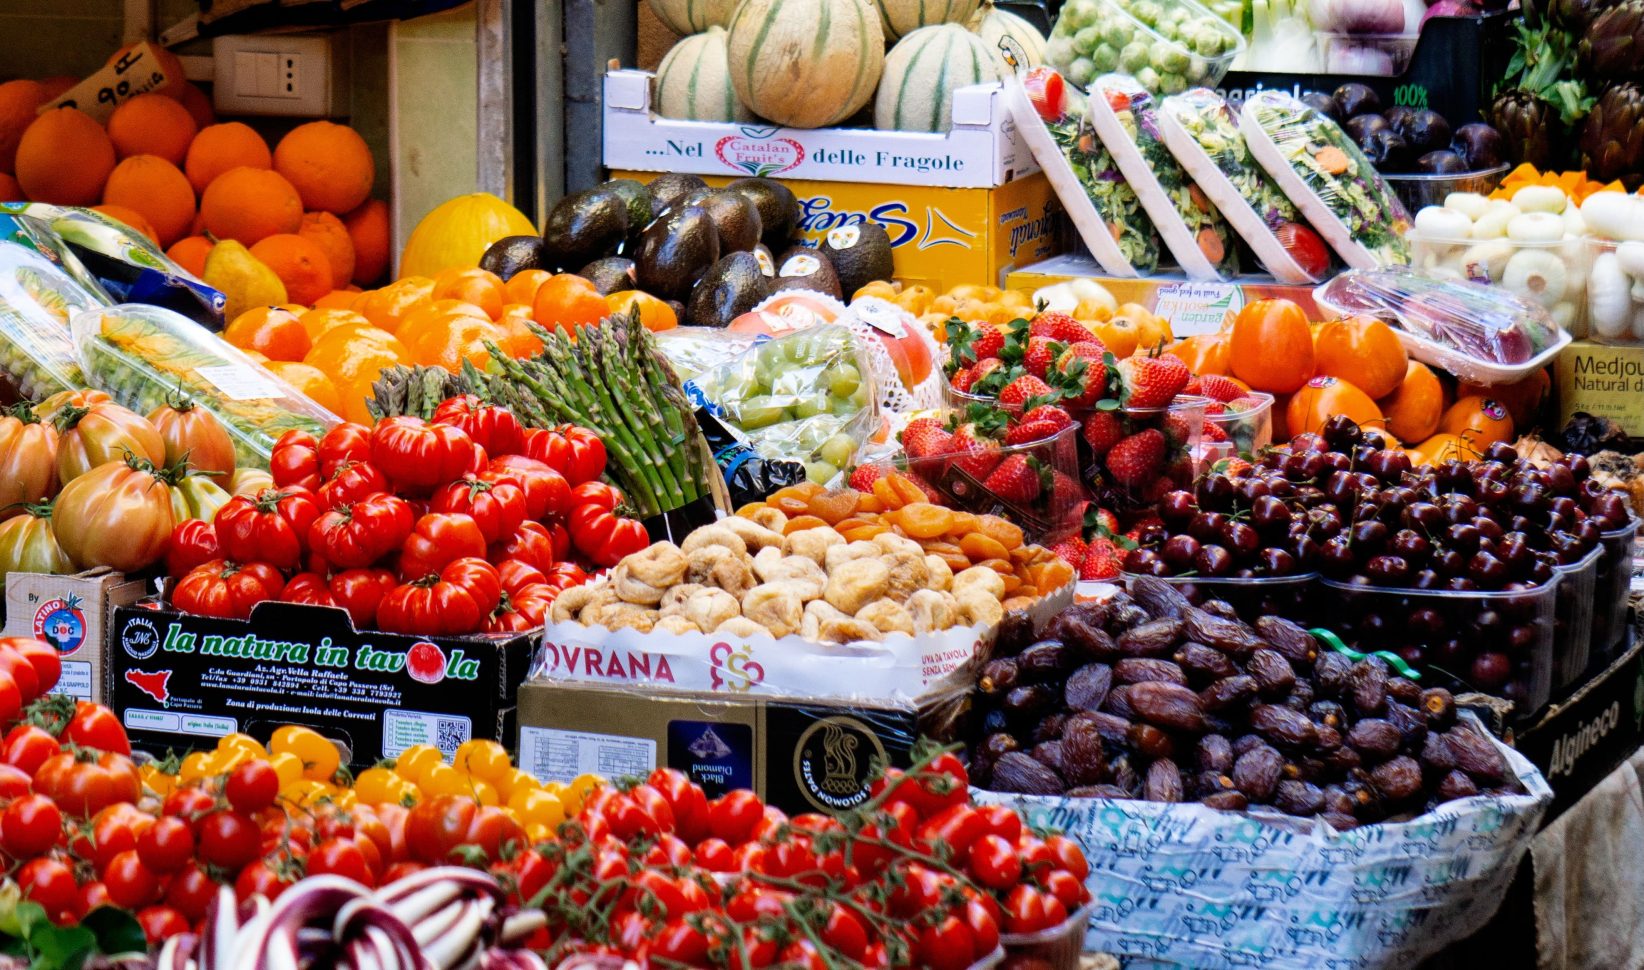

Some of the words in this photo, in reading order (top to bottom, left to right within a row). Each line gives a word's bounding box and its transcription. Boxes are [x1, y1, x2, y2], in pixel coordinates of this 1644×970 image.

[1393, 83, 1428, 106] 100%
[729, 140, 790, 153] Catalan
[735, 151, 786, 164] Fruit's
[812, 148, 866, 165] delle
[875, 151, 965, 172] Fragole
[1181, 312, 1224, 325] garden
[1574, 376, 1629, 392] Natural
[28, 592, 40, 604] By
[34, 602, 61, 635] LATINO
[128, 617, 153, 630] ITALIA
[163, 623, 197, 652] la
[200, 633, 310, 664] natura
[314, 637, 350, 668] in
[921, 653, 935, 665] UVA
[942, 648, 969, 662] TAVOLA
[201, 673, 227, 681] Tel/fax
[311, 669, 348, 679] Raffaele
[921, 664, 942, 677] SENZA
[282, 674, 318, 684] Portopalo
[328, 679, 347, 687] Capo
[348, 681, 377, 689] Passero
[225, 698, 244, 707] Zona
[246, 700, 254, 708] di
[256, 701, 300, 714] produzione:
[302, 705, 321, 715] Isola
[323, 707, 341, 717] delle
[343, 709, 376, 720] Correnti
[1547, 700, 1619, 779] Algineco
[692, 763, 733, 776] Diamond
[802, 759, 819, 793] DATES
[701, 773, 724, 784] Black
[817, 789, 868, 807] SOLOMON
